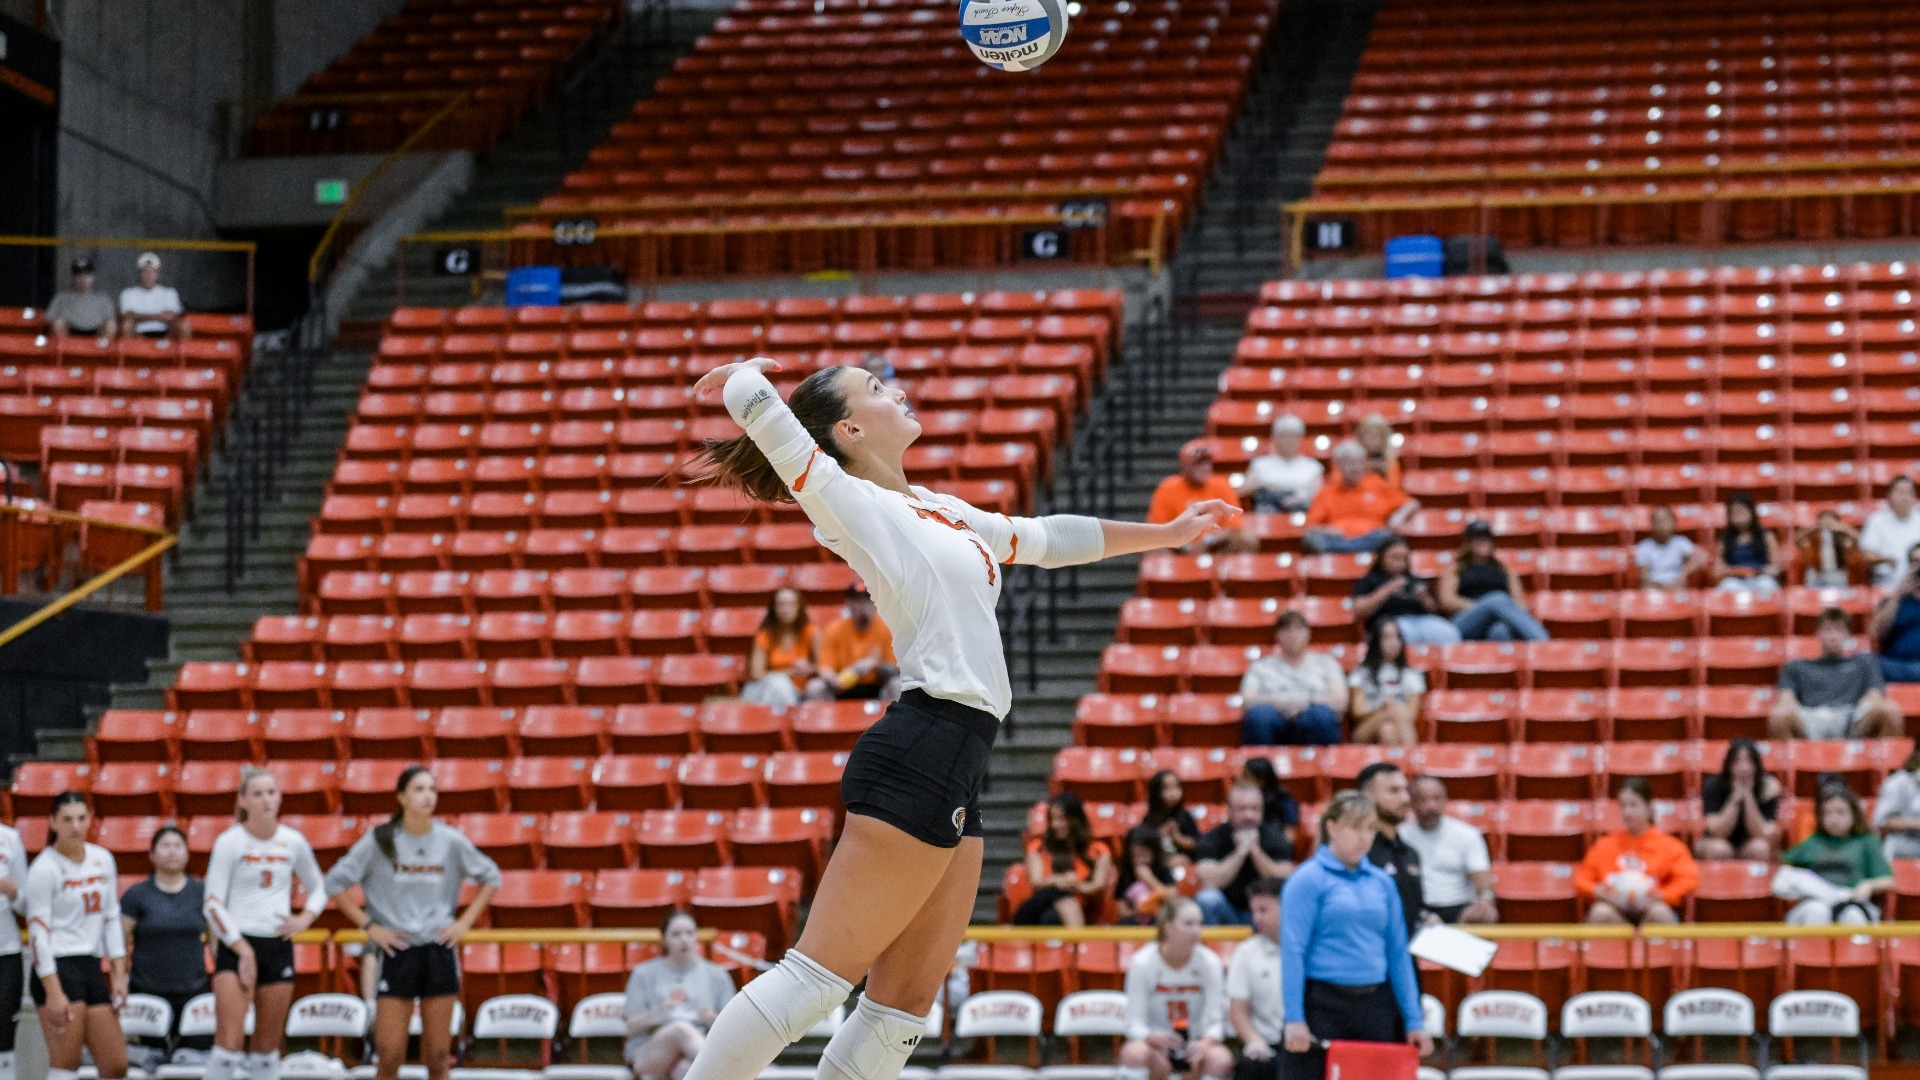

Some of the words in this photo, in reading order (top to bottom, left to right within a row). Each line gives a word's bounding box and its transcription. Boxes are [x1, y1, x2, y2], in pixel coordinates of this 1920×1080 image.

[974, 7, 999, 20] Touch
[1002, 3, 1029, 17] Super
[979, 25, 1027, 45] NCAA
[979, 42, 1039, 62] molten
[1032, 231, 1058, 258] G
[446, 249, 469, 274] G
[261, 870, 272, 888] 3
[82, 891, 101, 914] 12
